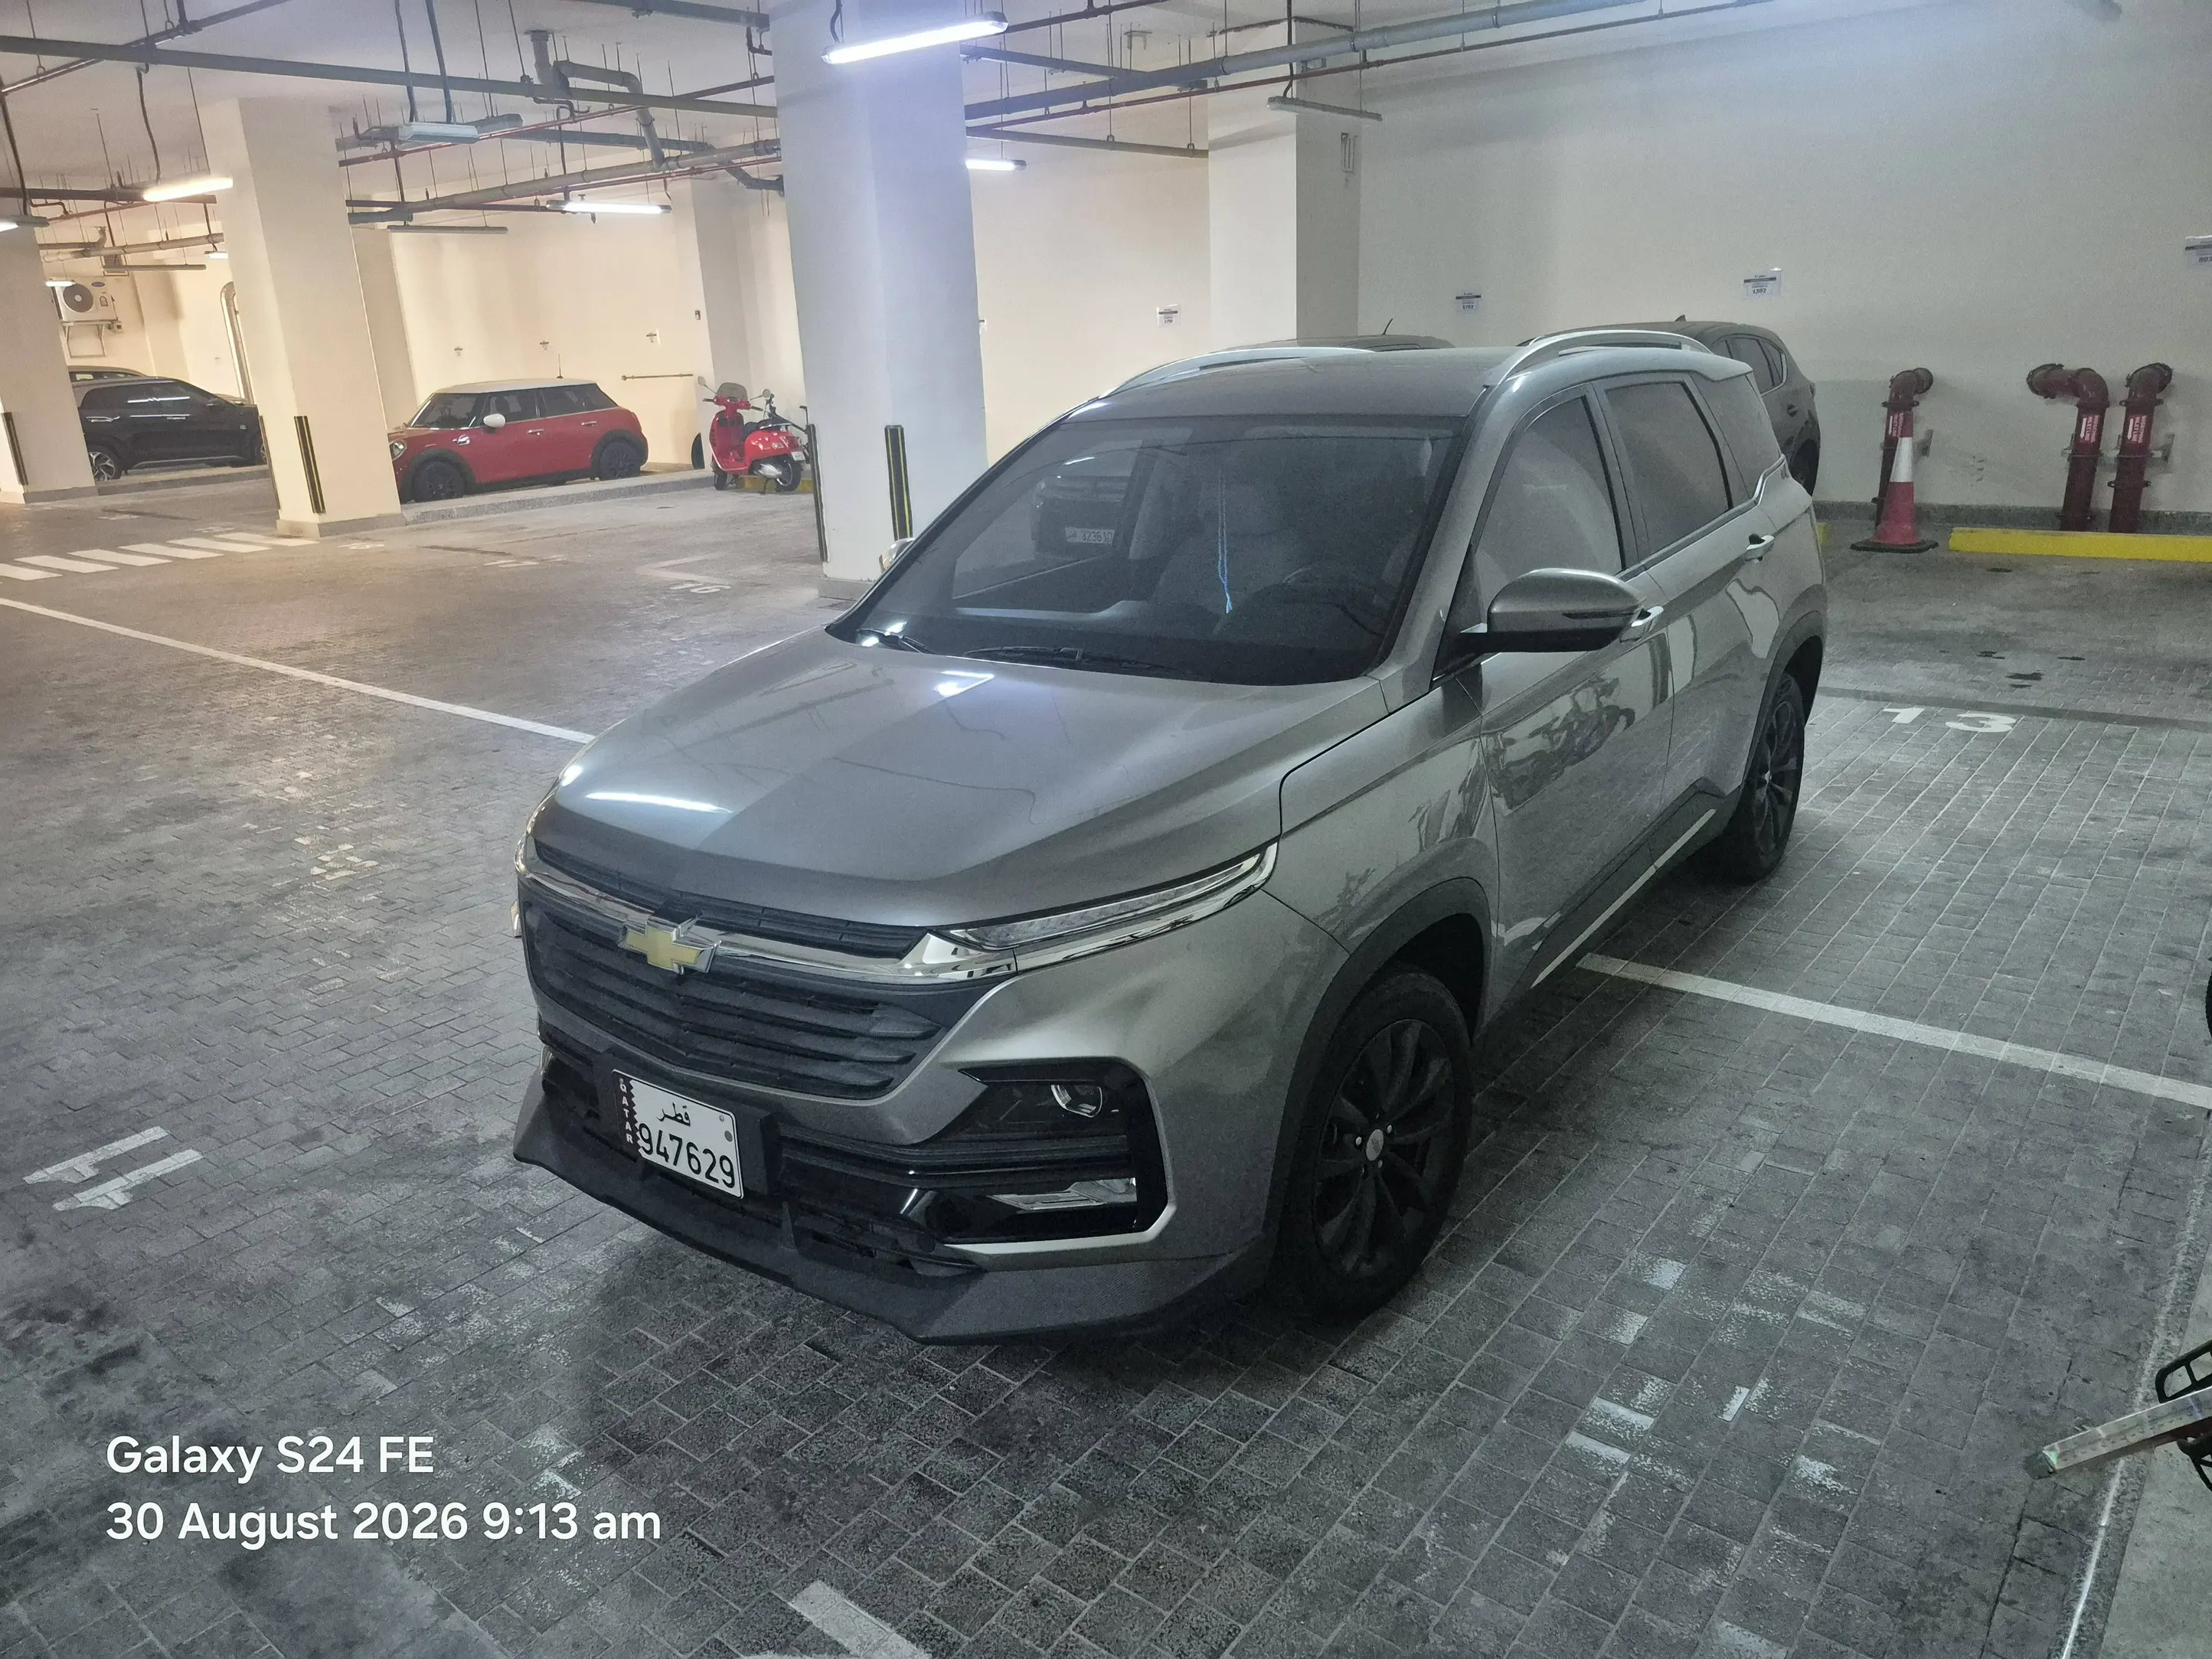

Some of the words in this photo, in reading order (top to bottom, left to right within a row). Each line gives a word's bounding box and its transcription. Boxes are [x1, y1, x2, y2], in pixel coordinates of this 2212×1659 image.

[1883, 707, 2017, 733] 13
[619, 1082, 634, 1145] QATAR
[655, 1102, 691, 1127] قطر
[638, 1122, 736, 1189] 947629
